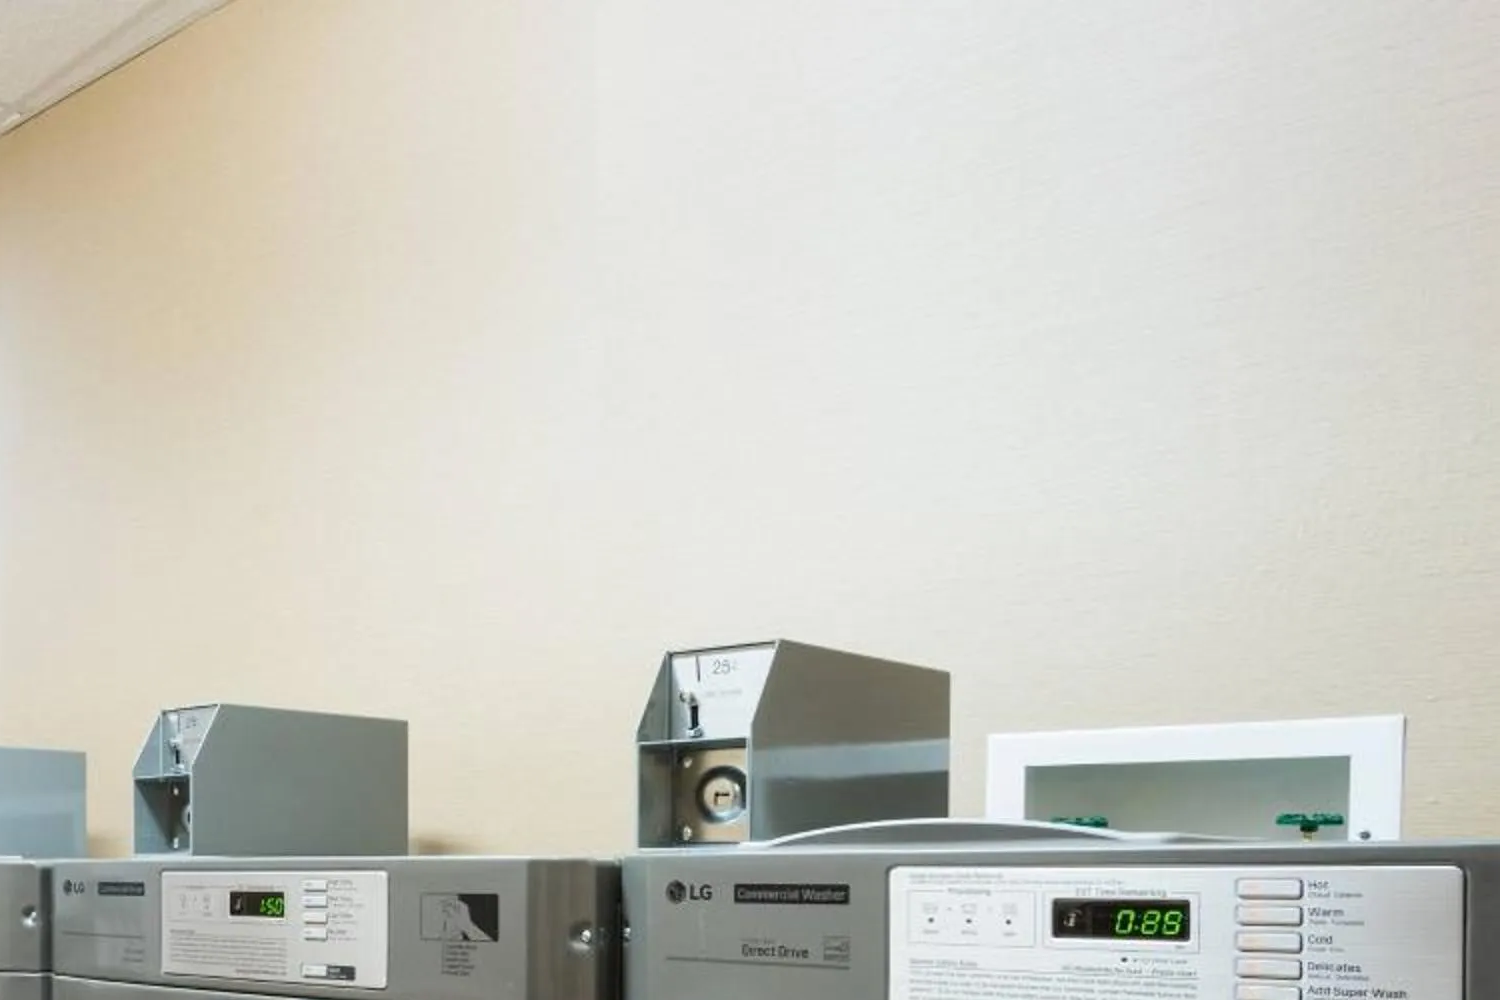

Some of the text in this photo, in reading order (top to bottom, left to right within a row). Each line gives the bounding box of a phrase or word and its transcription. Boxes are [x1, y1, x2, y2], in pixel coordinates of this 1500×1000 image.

[689, 884, 713, 901] LG
[801, 887, 847, 901] Washer
[1307, 907, 1344, 917] Warm
[778, 945, 809, 959] Drive
[1333, 986, 1368, 998] Super
